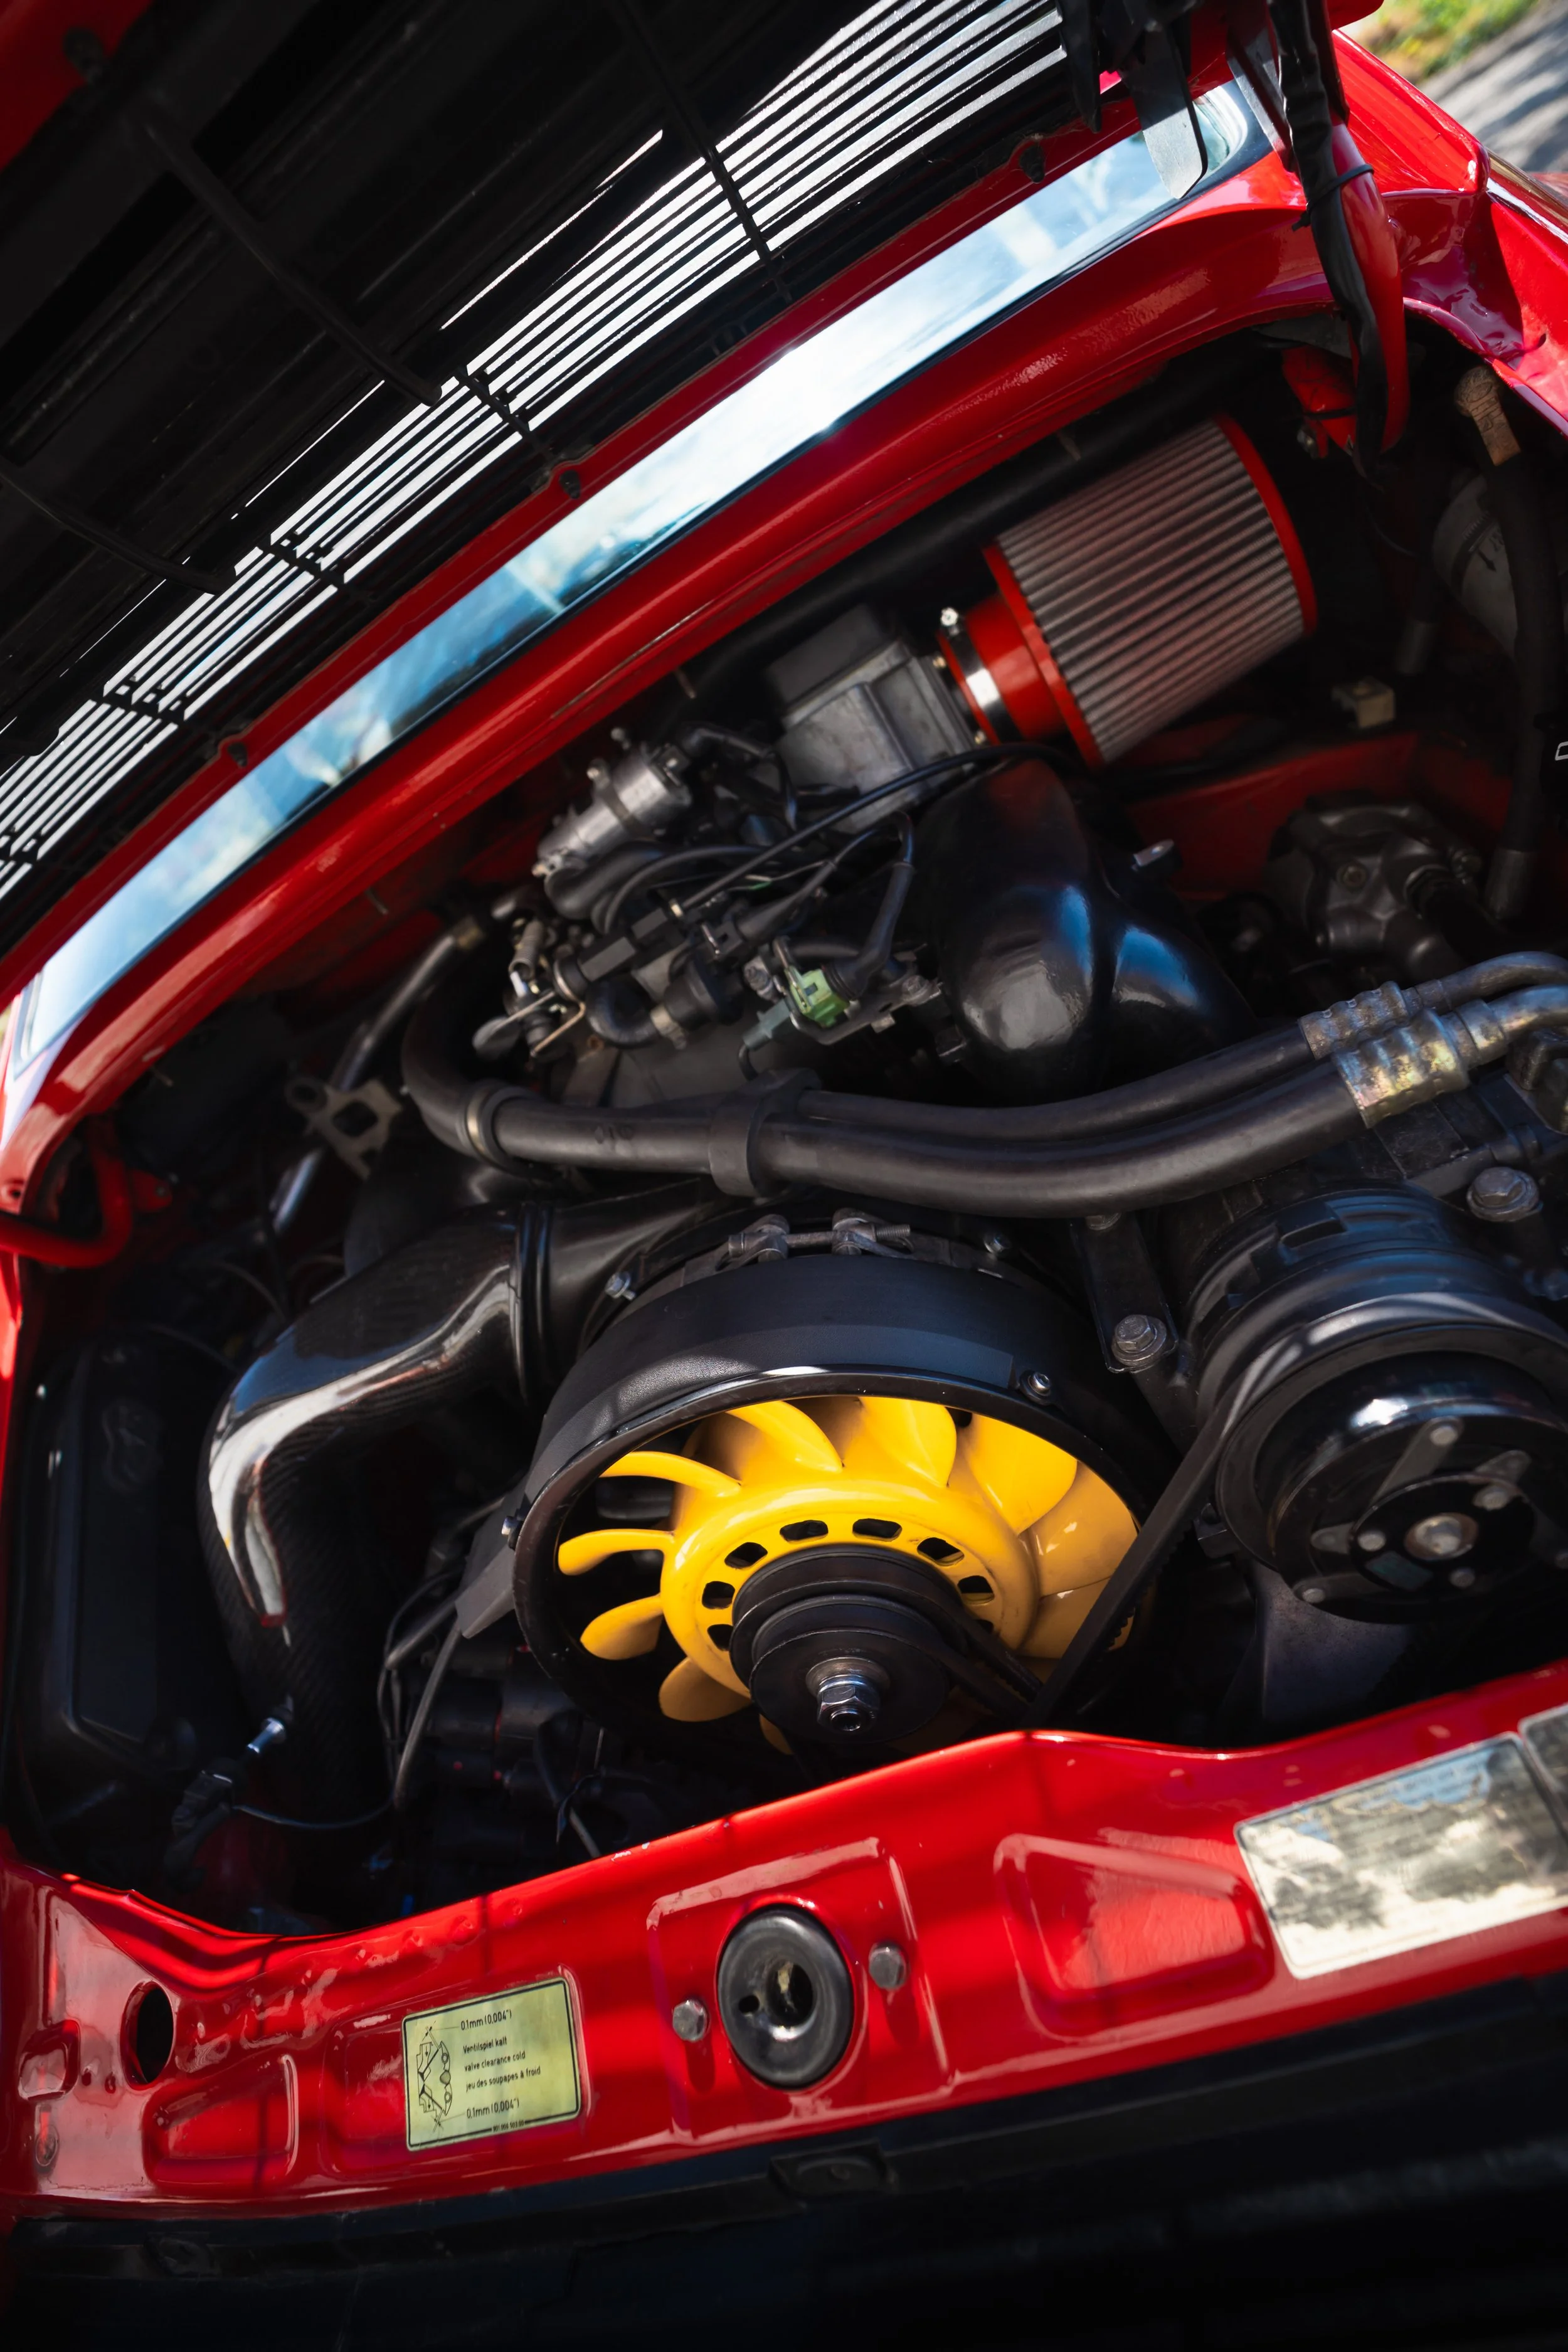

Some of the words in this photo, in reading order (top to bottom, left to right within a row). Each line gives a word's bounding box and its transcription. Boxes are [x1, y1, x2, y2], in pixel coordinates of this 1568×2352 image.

[463, 2039, 494, 2053] Ventilspiel
[495, 2036, 507, 2047] kalt
[464, 2062, 480, 2072] valve
[481, 2056, 511, 2069] clearance
[512, 2050, 526, 2061] cold
[466, 2082, 475, 2092] jeu
[477, 2077, 487, 2088] des
[489, 2072, 519, 2085] soupapes
[520, 2070, 524, 2079] à
[526, 2065, 541, 2077] froid
